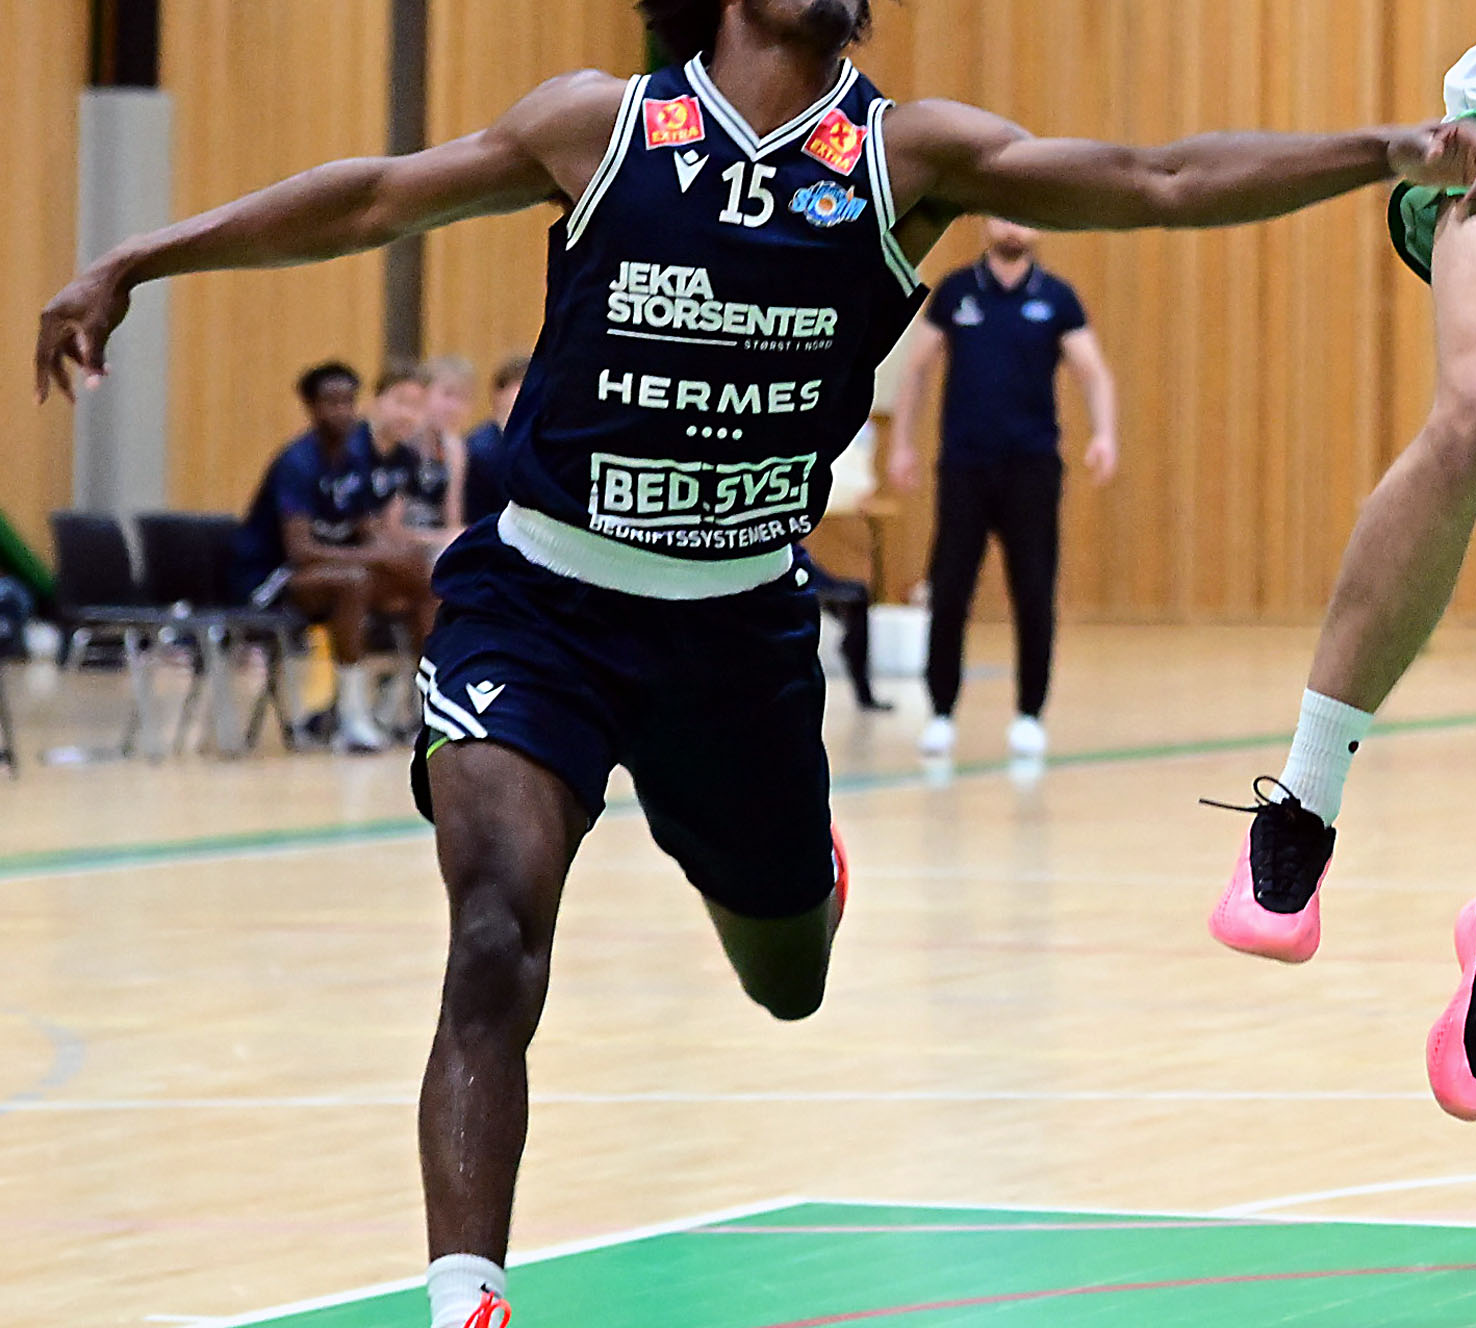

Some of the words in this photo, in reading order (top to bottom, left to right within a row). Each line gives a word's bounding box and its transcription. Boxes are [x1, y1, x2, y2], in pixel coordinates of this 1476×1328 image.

[809, 138, 851, 171] EXTRA
[719, 161, 777, 227] 15
[609, 261, 714, 300] JEKTA
[606, 292, 838, 338] STORSENTER
[598, 369, 822, 415] HERMES
[603, 464, 800, 514] BED.SYS.
[788, 514, 812, 534] AS
